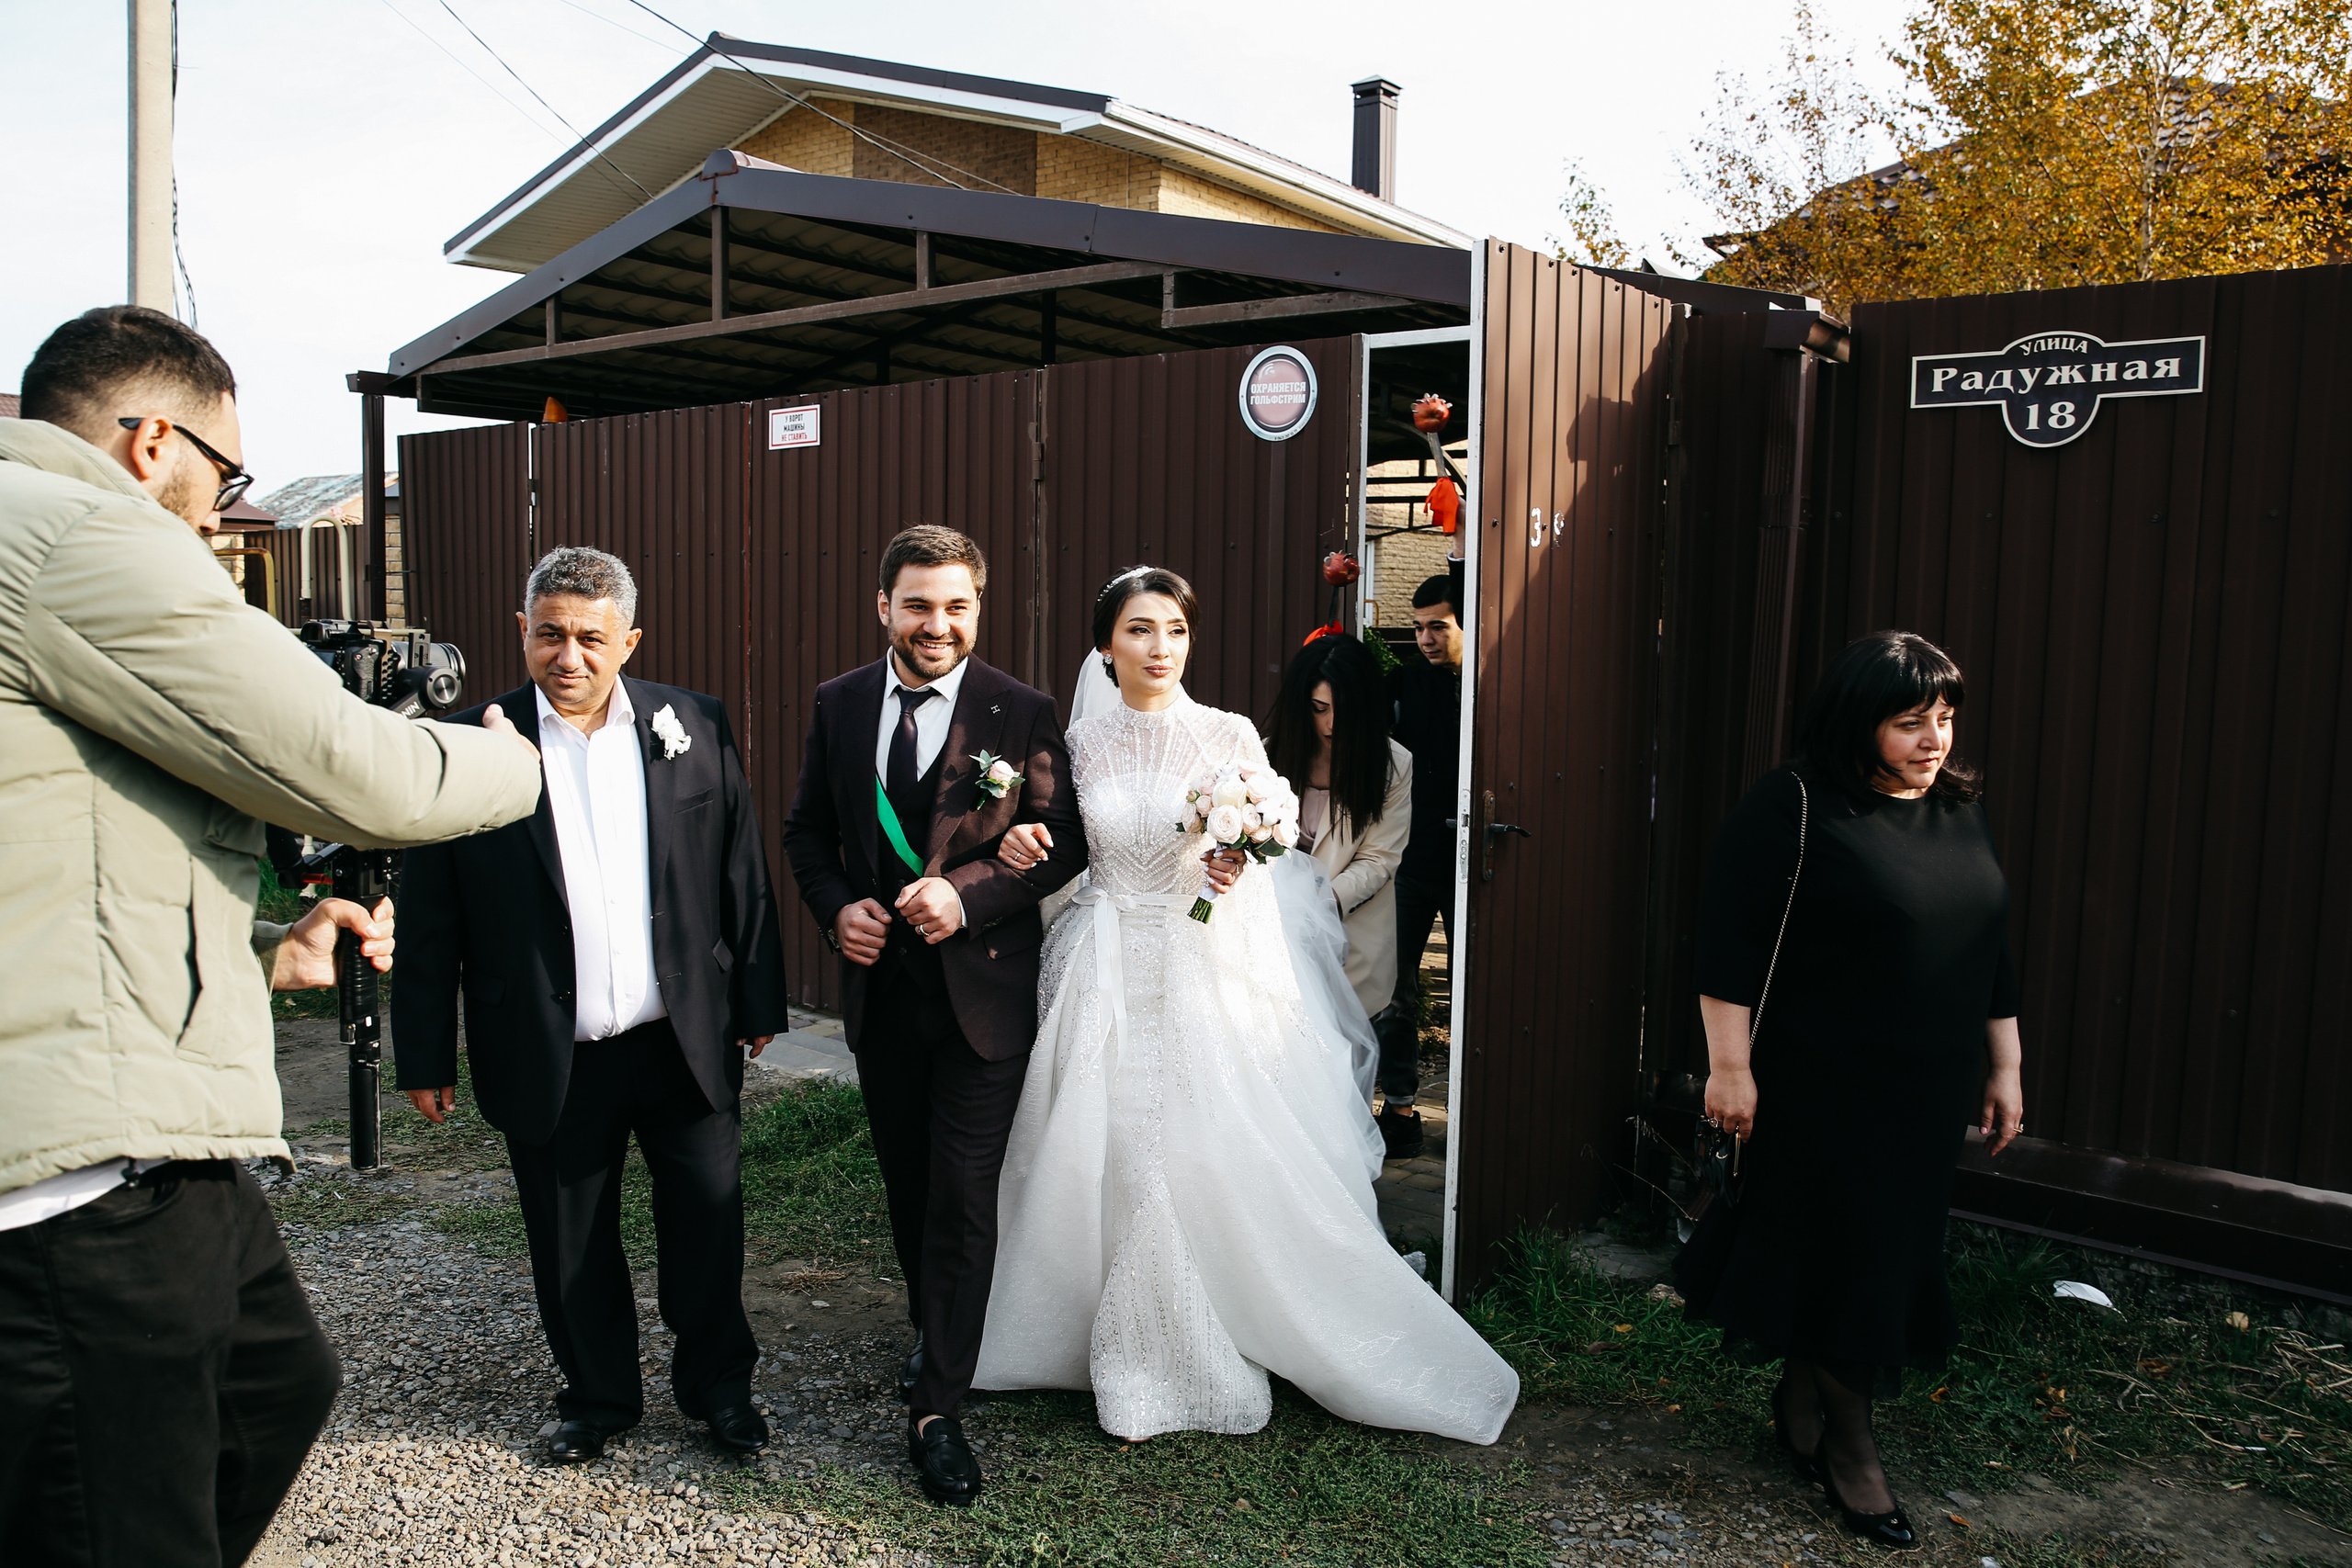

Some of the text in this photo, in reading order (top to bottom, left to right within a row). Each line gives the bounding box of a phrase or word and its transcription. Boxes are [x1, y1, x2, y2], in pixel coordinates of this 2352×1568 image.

[2019, 337, 2087, 355] УЛИЦА
[1931, 357, 2182, 395] Радужная
[1250, 381, 1306, 394] ОХРАНЯЕТСЯ
[1250, 393, 1306, 405] ГОЛЬФСТРИМ
[789, 413, 804, 423] ВОРОТ
[2025, 401, 2076, 430] 18
[783, 423, 806, 432] МАШИНЫ
[788, 432, 808, 441] СТАВИТЬ
[401, 701, 420, 718] NIN
